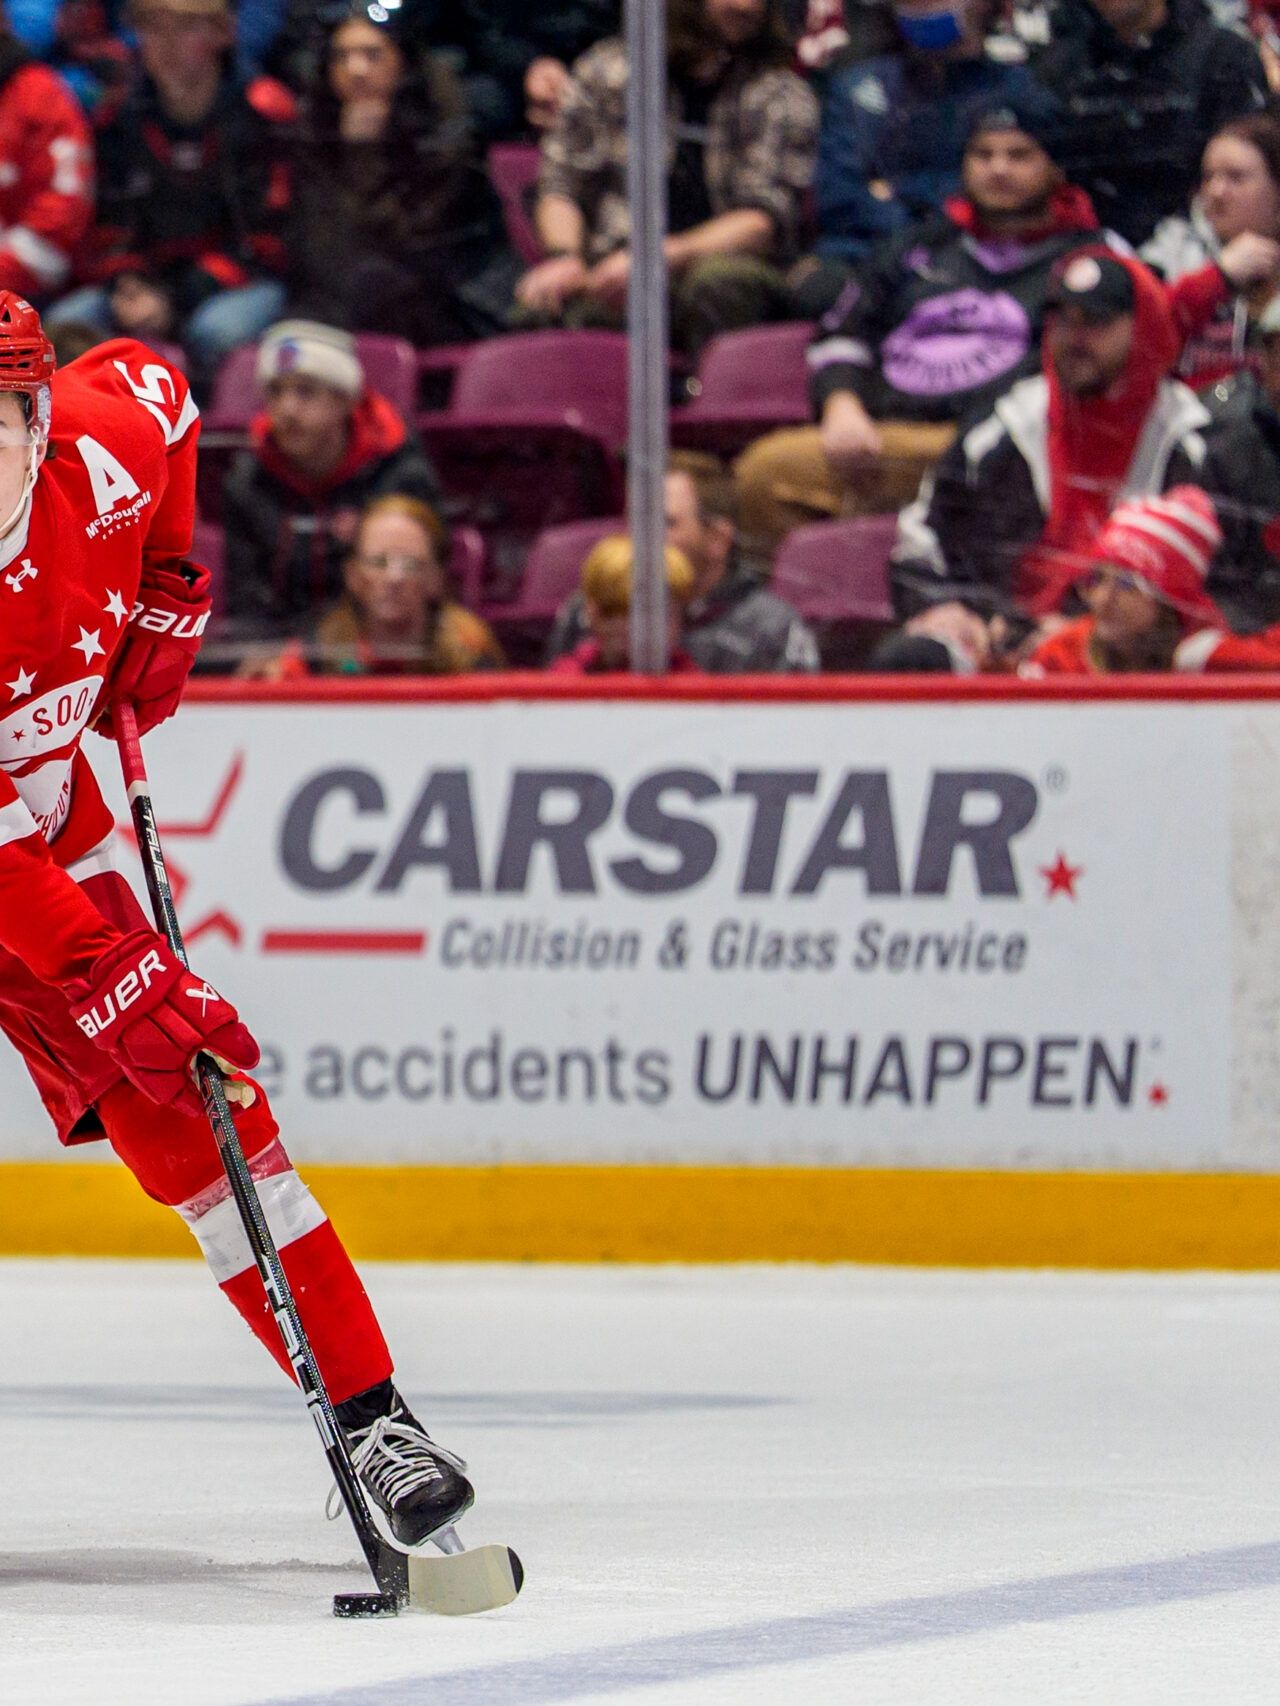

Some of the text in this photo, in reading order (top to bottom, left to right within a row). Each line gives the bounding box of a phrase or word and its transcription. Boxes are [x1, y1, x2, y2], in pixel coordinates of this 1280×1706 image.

[75, 434, 140, 516] A
[32, 687, 89, 736] SOO
[278, 766, 1040, 898] CARSTAR
[439, 919, 1028, 973] Collision & Glass Service
[305, 1027, 671, 1101] accidents
[695, 1034, 1137, 1106] UNHAPPEN
